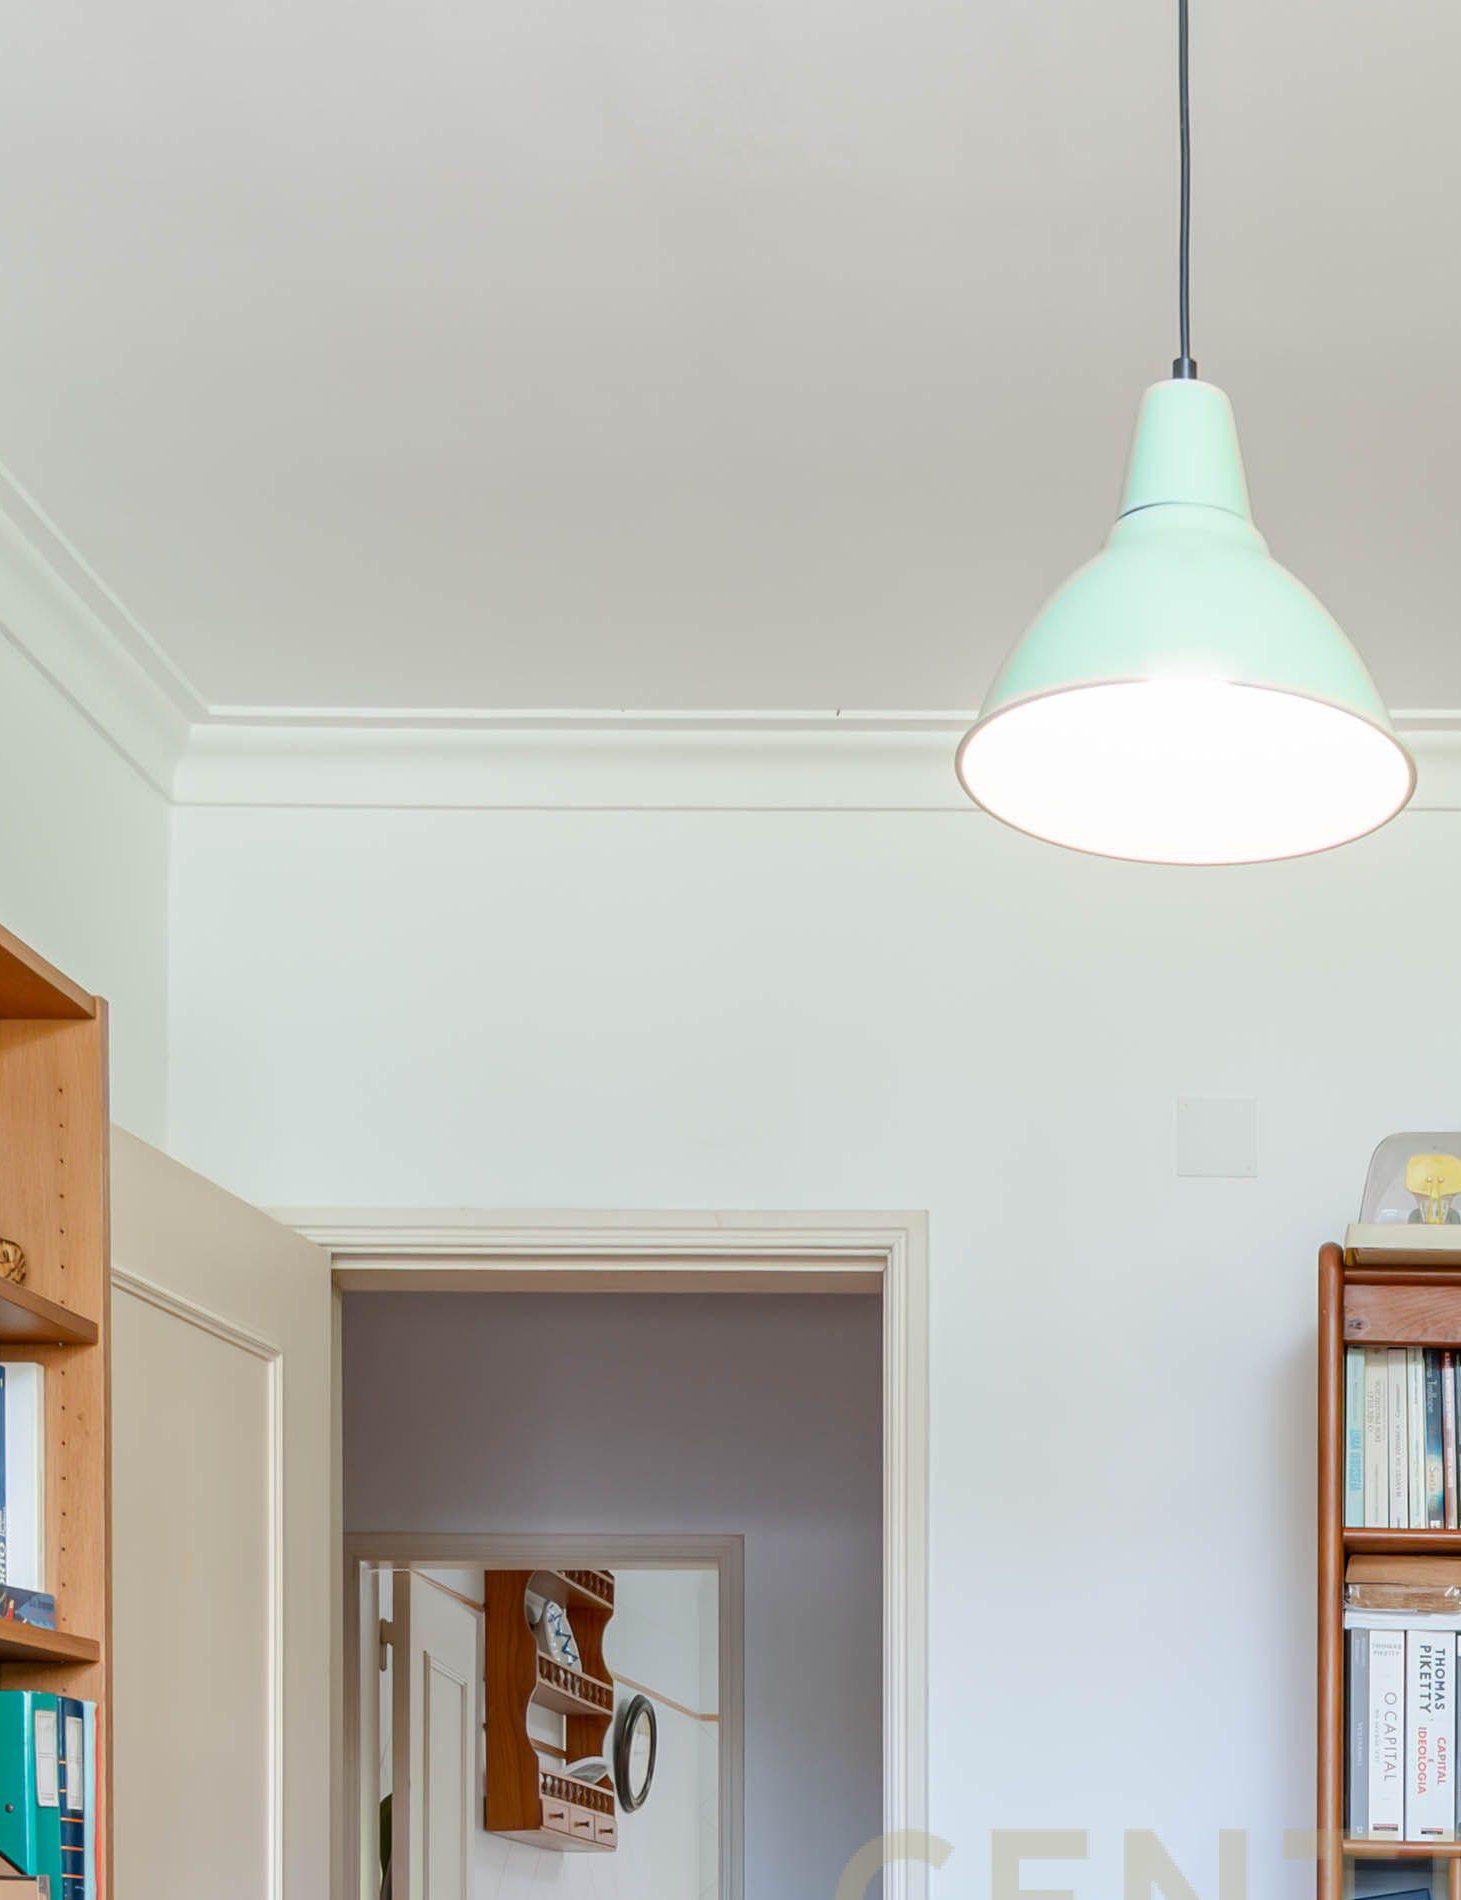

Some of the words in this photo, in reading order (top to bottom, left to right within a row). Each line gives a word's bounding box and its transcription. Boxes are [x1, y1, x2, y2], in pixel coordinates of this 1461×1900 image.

[1383, 1691, 1398, 1706] O
[1419, 1644, 1433, 1714] PIKETTY
[1434, 1647, 1446, 1711] THOMAS
[1383, 1710, 1398, 1781] CAPITAL
[1417, 1726, 1428, 1796] IDEOLOGIA
[1436, 1737, 1447, 1785] CAPITAL
